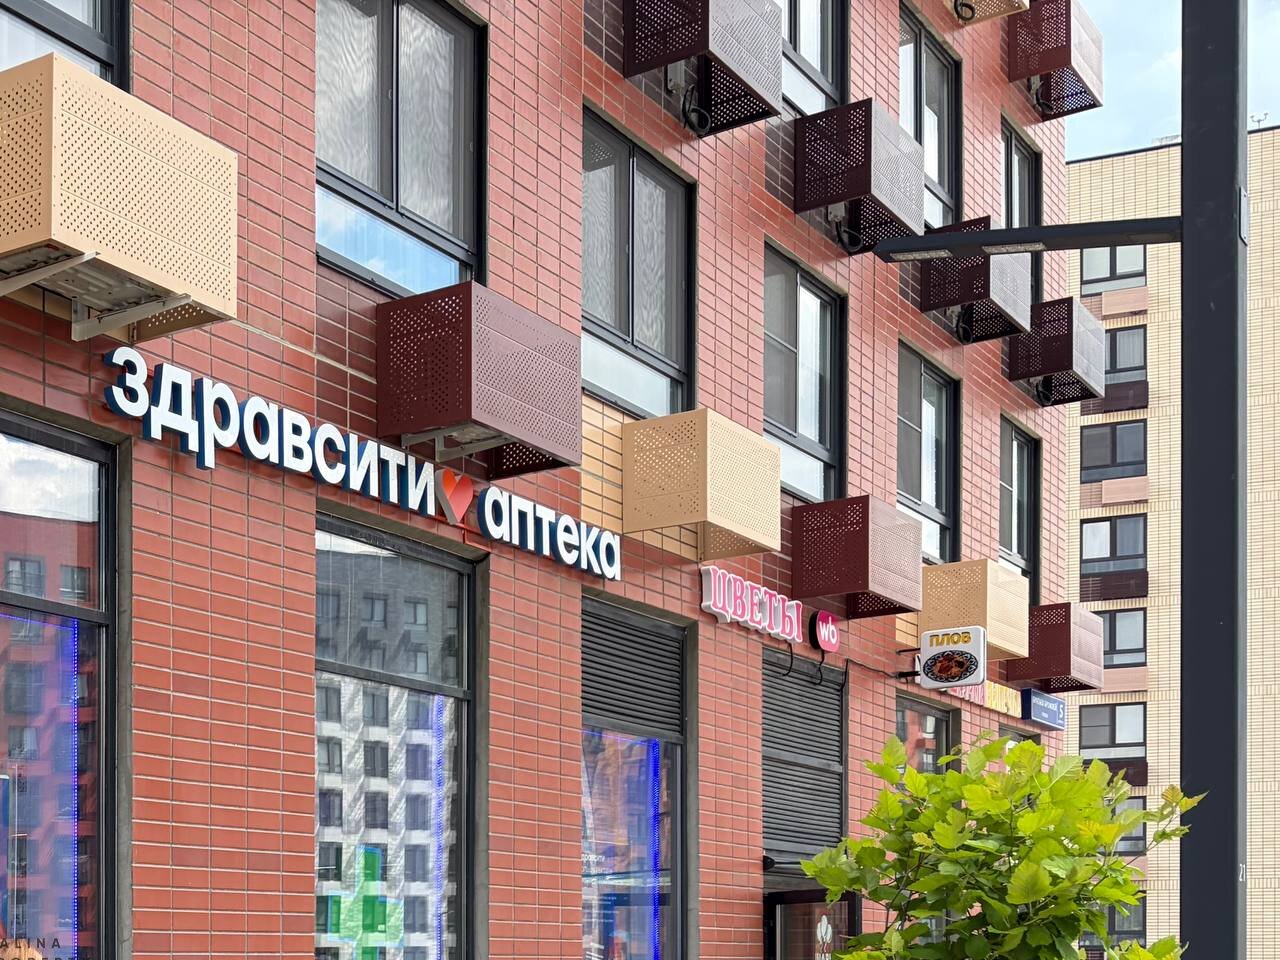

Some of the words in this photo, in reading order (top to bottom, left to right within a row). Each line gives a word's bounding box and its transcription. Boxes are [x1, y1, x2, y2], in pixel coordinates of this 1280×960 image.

[106, 346, 436, 517] здравсити
[478, 485, 622, 581] аптека
[706, 565, 803, 643] ЦВЕТЫ
[820, 616, 838, 645] wb
[929, 631, 972, 648] ПЛОВ
[1239, 863, 1246, 882] 21
